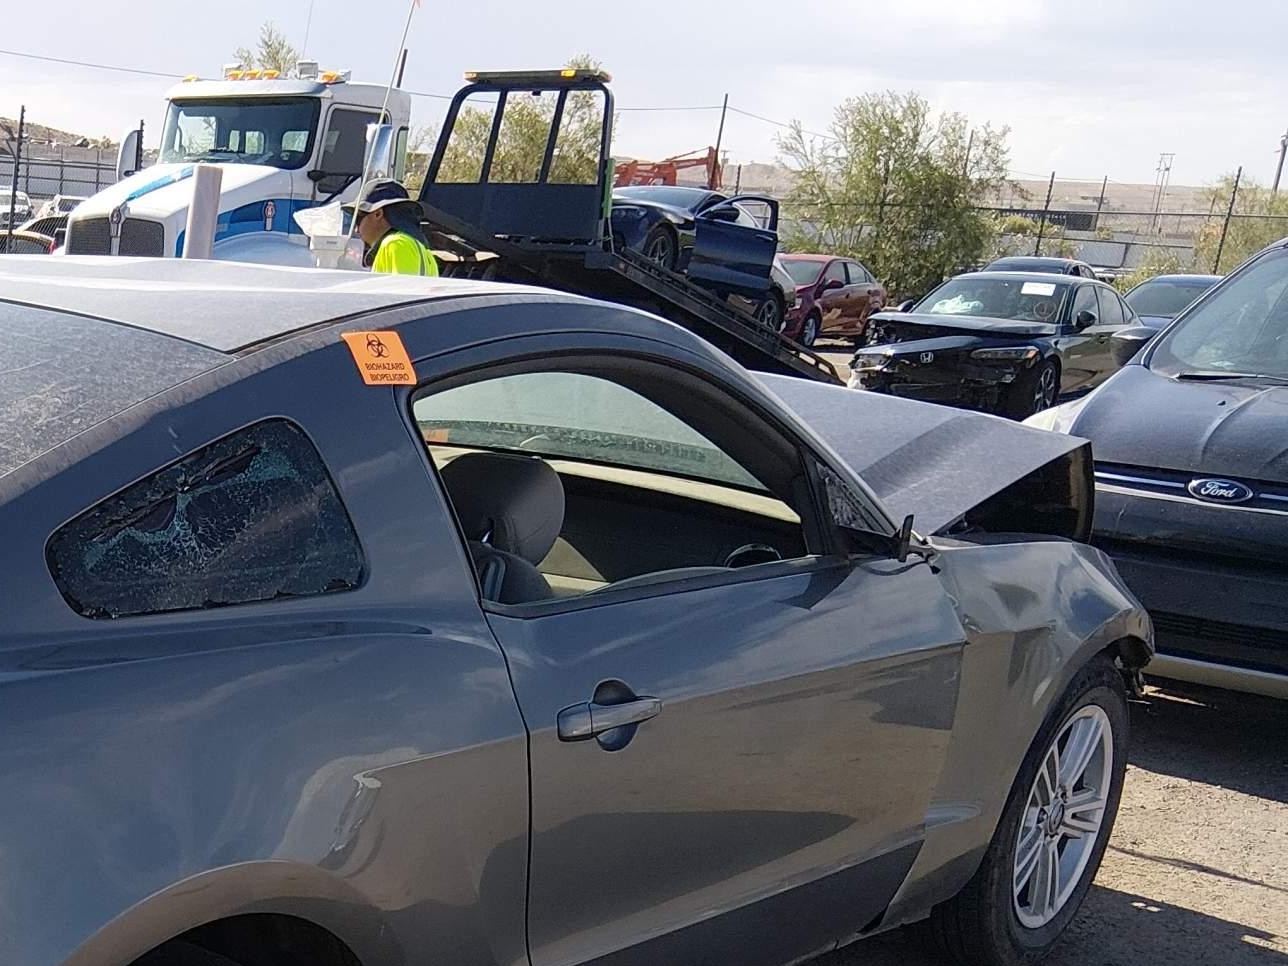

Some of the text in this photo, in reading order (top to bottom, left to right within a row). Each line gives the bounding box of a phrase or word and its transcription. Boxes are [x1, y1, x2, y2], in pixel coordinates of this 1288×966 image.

[364, 362, 405, 371] BIOHAZARD
[369, 373, 410, 382] BIOPELIGRO
[1200, 481, 1238, 498] Ford
